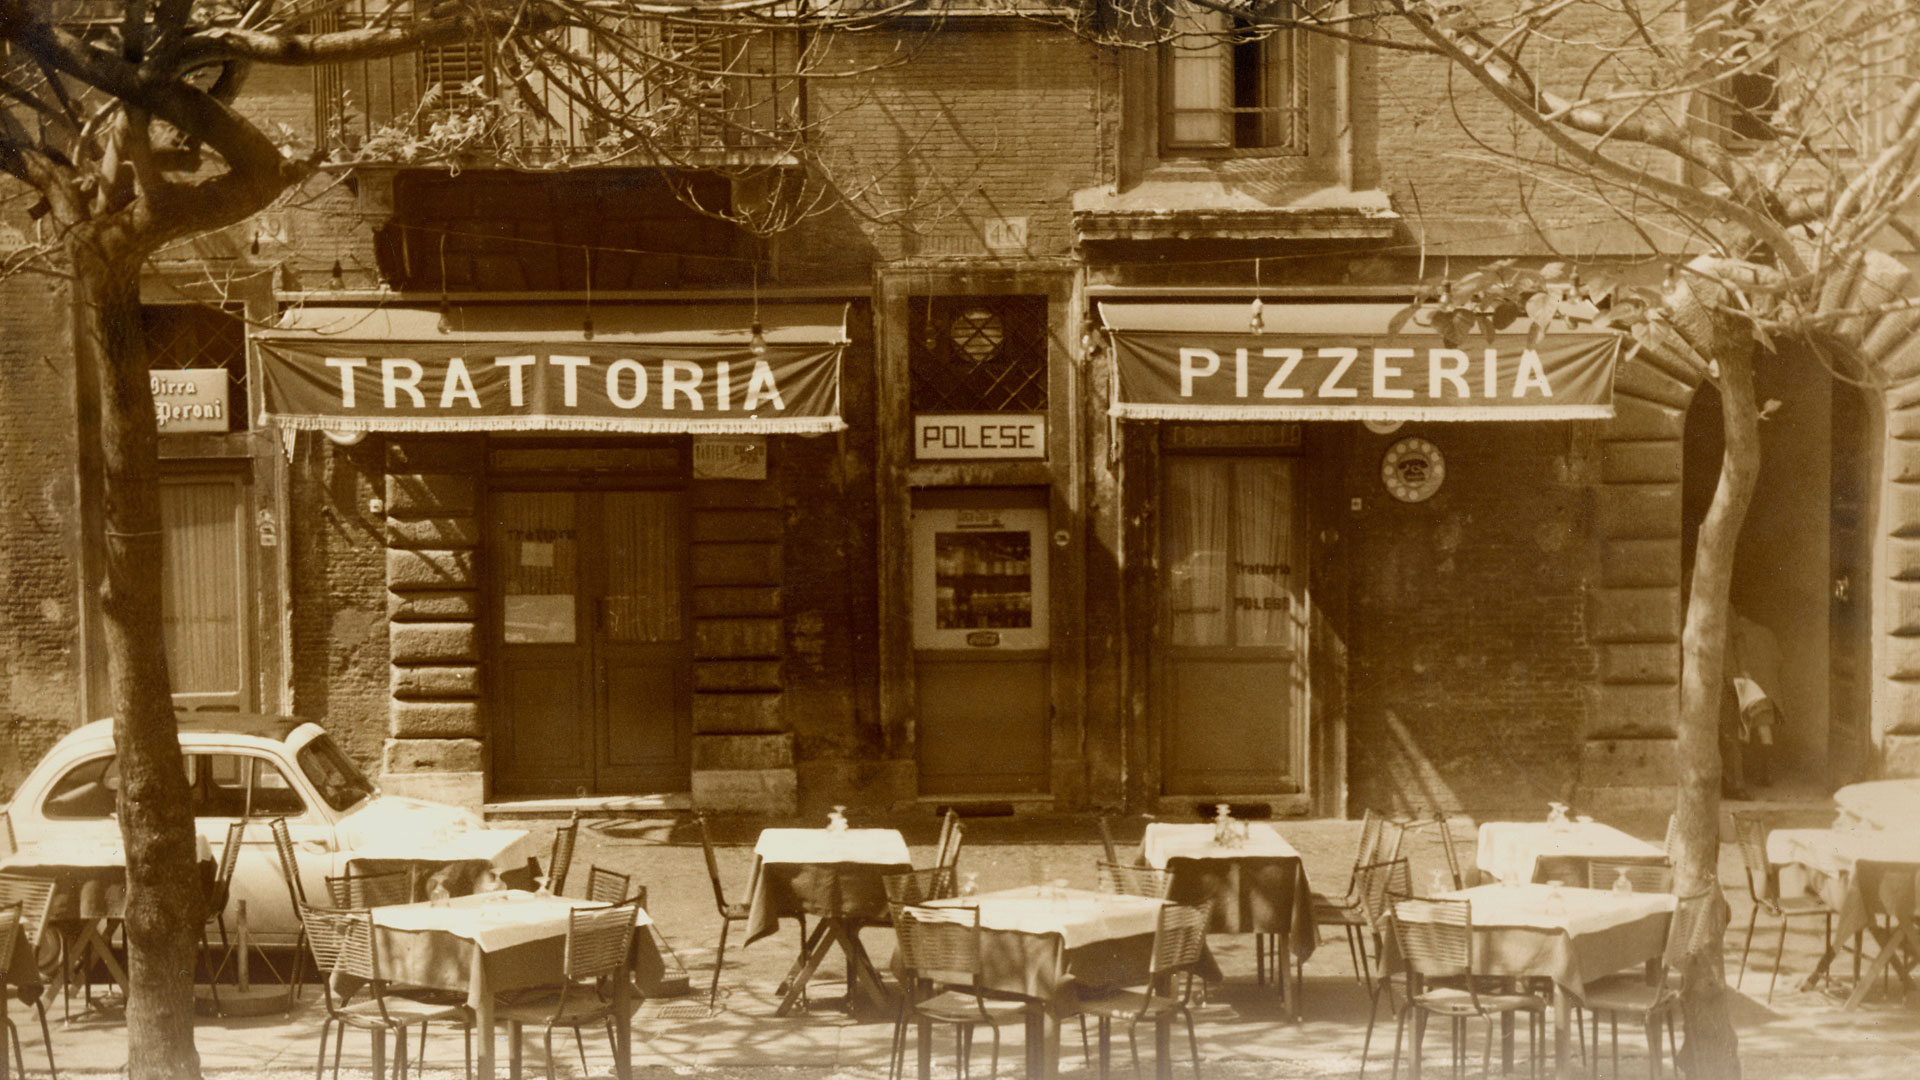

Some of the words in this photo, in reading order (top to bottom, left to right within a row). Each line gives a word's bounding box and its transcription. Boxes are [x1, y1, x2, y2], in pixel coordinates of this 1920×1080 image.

[151, 376, 198, 395] Birra
[325, 354, 786, 412] TRATTORIA
[1178, 347, 1554, 399] PIZZERIA
[154, 399, 222, 426] Peroni
[922, 425, 1035, 449] POLESE
